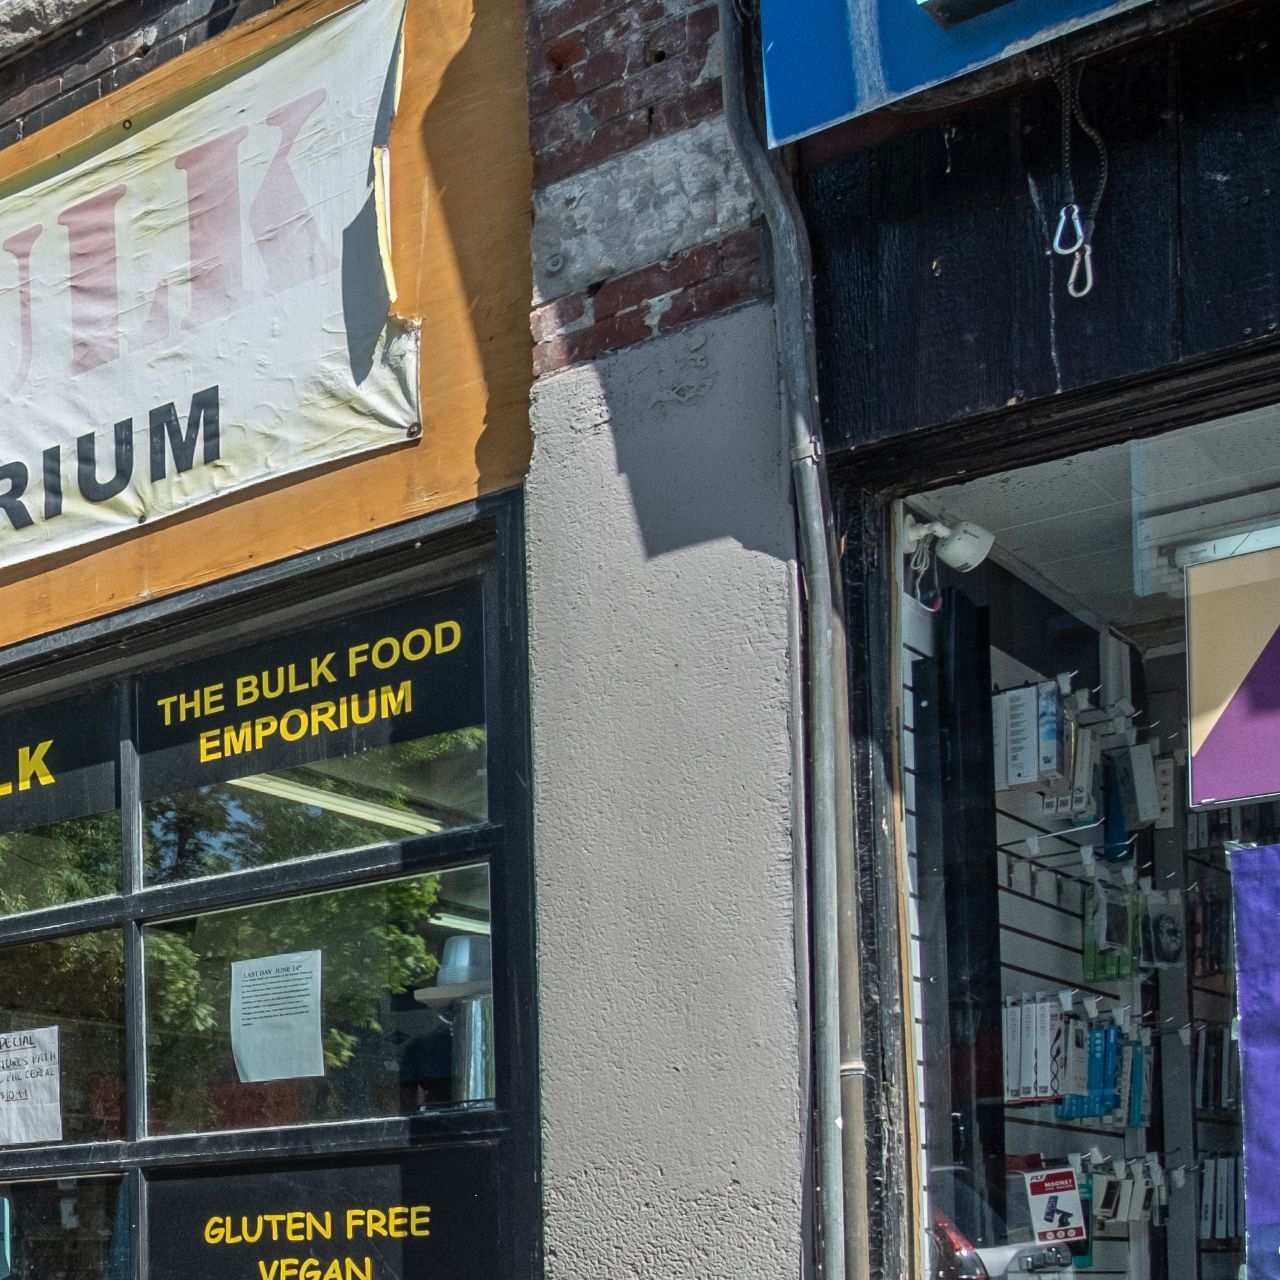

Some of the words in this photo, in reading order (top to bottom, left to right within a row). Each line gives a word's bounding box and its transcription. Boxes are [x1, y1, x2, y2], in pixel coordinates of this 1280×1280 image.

[156, 683, 224, 727] THE
[234, 651, 337, 706] BULK
[347, 618, 462, 678] FOOD
[198, 680, 413, 764] EMPORIUM
[203, 1211, 332, 1244] GLUTEN
[346, 1206, 431, 1239] FREE
